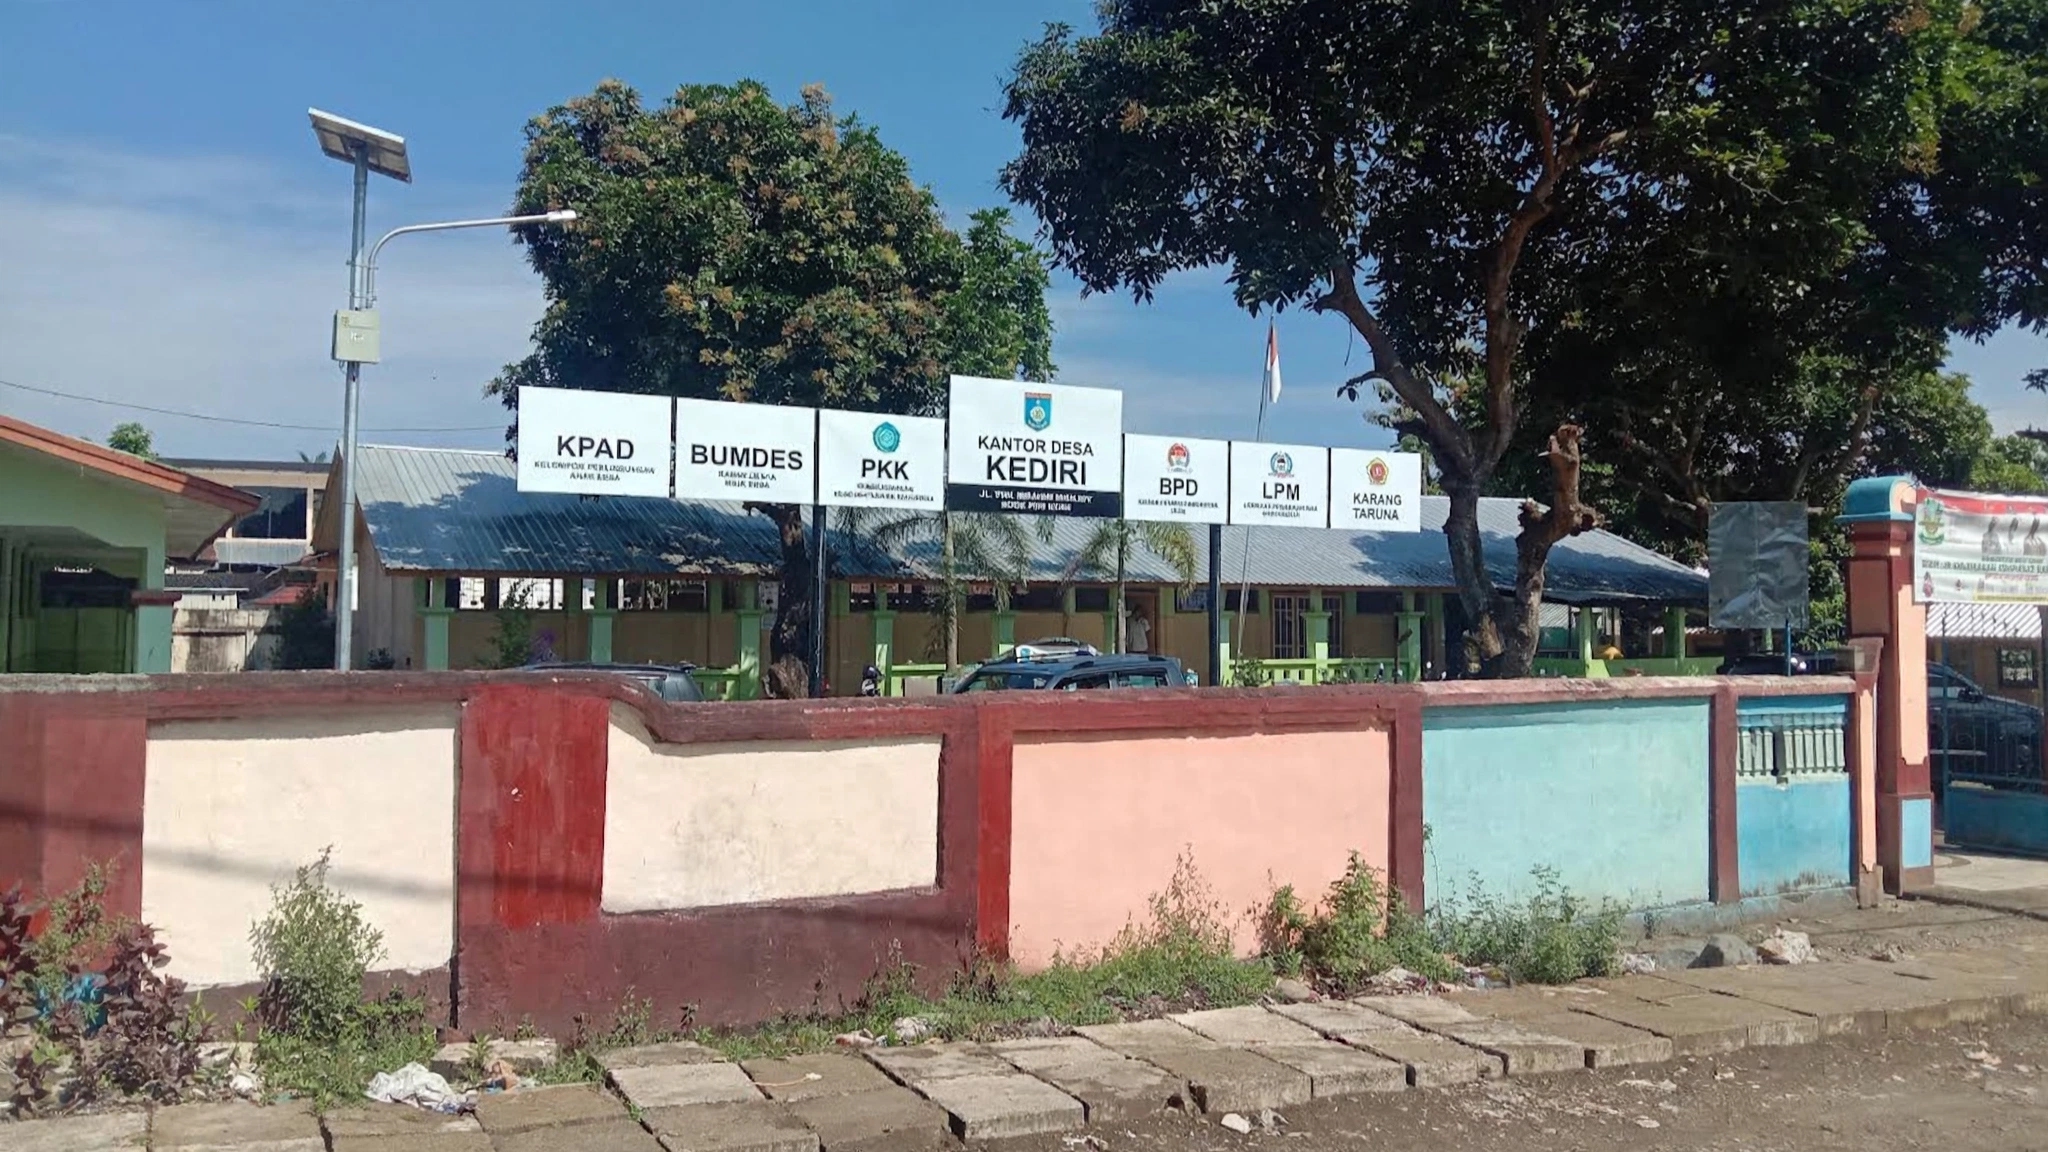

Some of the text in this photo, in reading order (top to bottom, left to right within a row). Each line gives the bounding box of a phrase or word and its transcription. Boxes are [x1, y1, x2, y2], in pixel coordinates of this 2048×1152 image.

[557, 435, 635, 460] KPAD
[691, 443, 803, 471] BUMDES
[978, 435, 1094, 457] KANTOR DESA
[861, 458, 909, 480] PKK
[986, 455, 1087, 486] KEDIRI
[1159, 477, 1198, 496] BPD
[1263, 481, 1300, 501] LPM
[1353, 492, 1402, 506] KARANG
[1352, 507, 1399, 520] TARUNA
